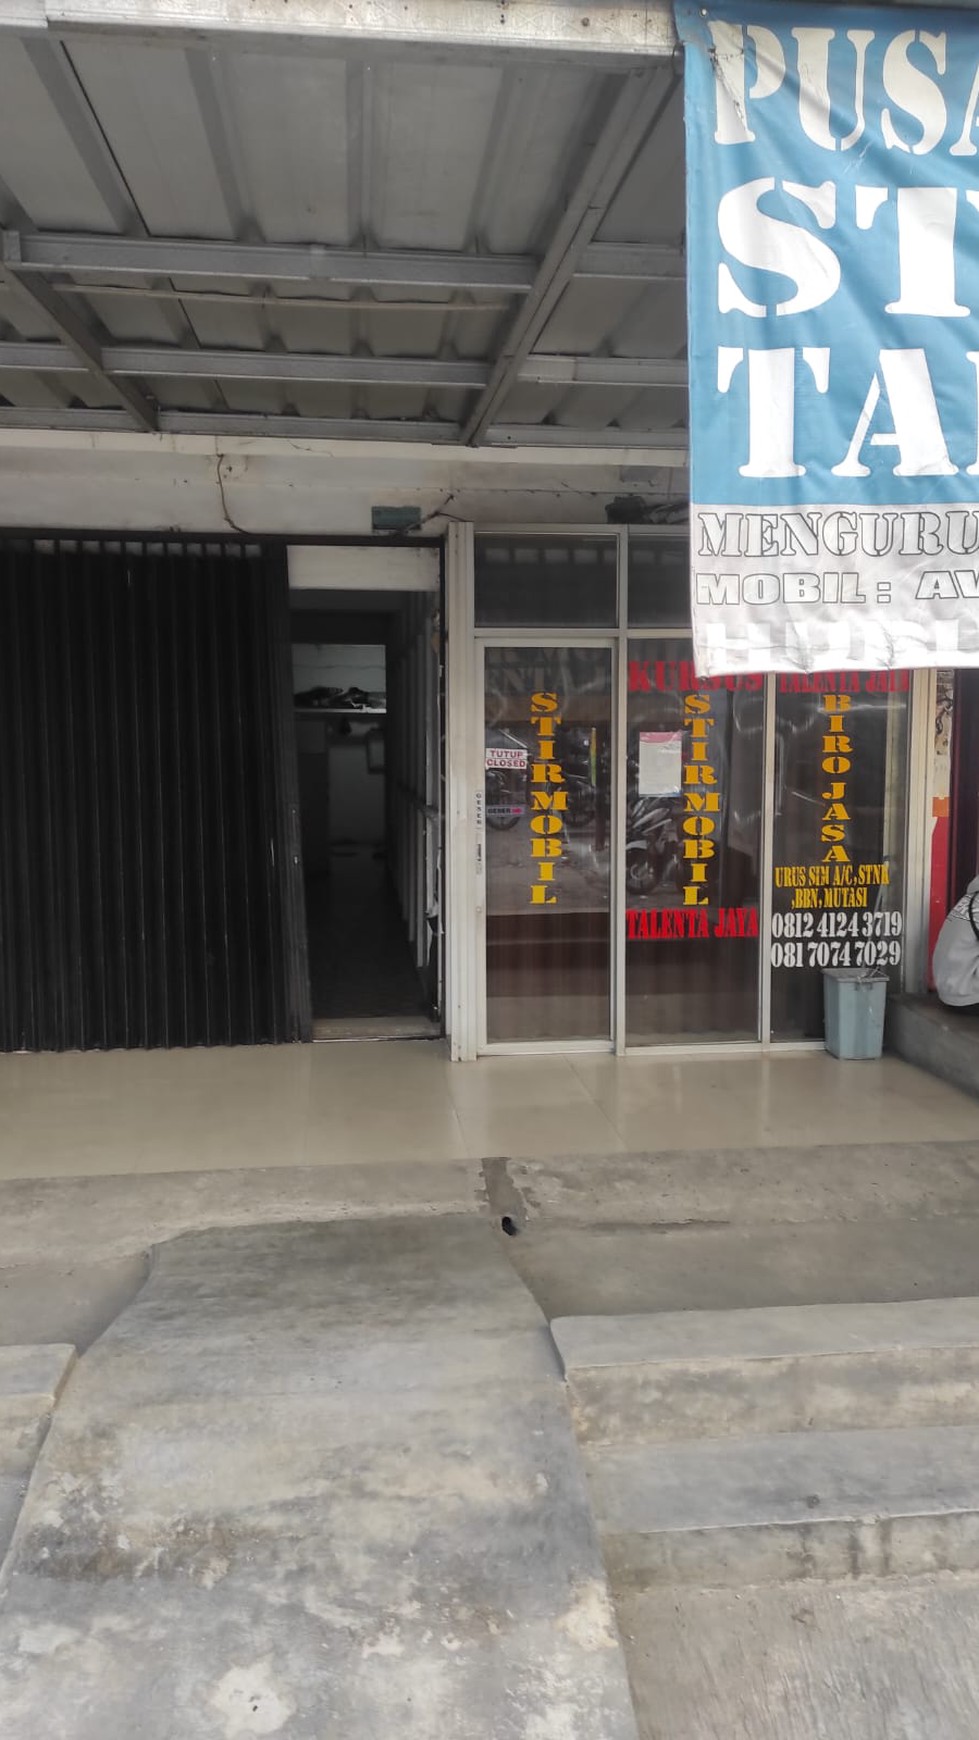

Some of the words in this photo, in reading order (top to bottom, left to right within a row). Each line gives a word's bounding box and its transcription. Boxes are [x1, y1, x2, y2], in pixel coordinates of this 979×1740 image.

[717, 177, 979, 318] ST
[717, 346, 979, 477] TA
[697, 510, 979, 557] MENGURU
[486, 759, 526, 768] CLOSED
[490, 750, 523, 758] TUTUP
[530, 692, 566, 784] STIR
[684, 694, 718, 785] STIR
[822, 694, 852, 774] BIRO
[529, 791, 568, 904] MOBIL
[682, 792, 720, 906] MOBIL
[821, 782, 850, 863] JASA
[775, 866, 806, 888] URUS
[626, 907, 710, 940] TALENTA
[714, 906, 759, 938] JAYA
[770, 941, 804, 968] 081
[807, 940, 852, 967] 7074
[854, 939, 901, 967] 7029
[772, 912, 815, 938] 0812
[816, 911, 860, 938] 4124
[861, 910, 903, 937] 3719
